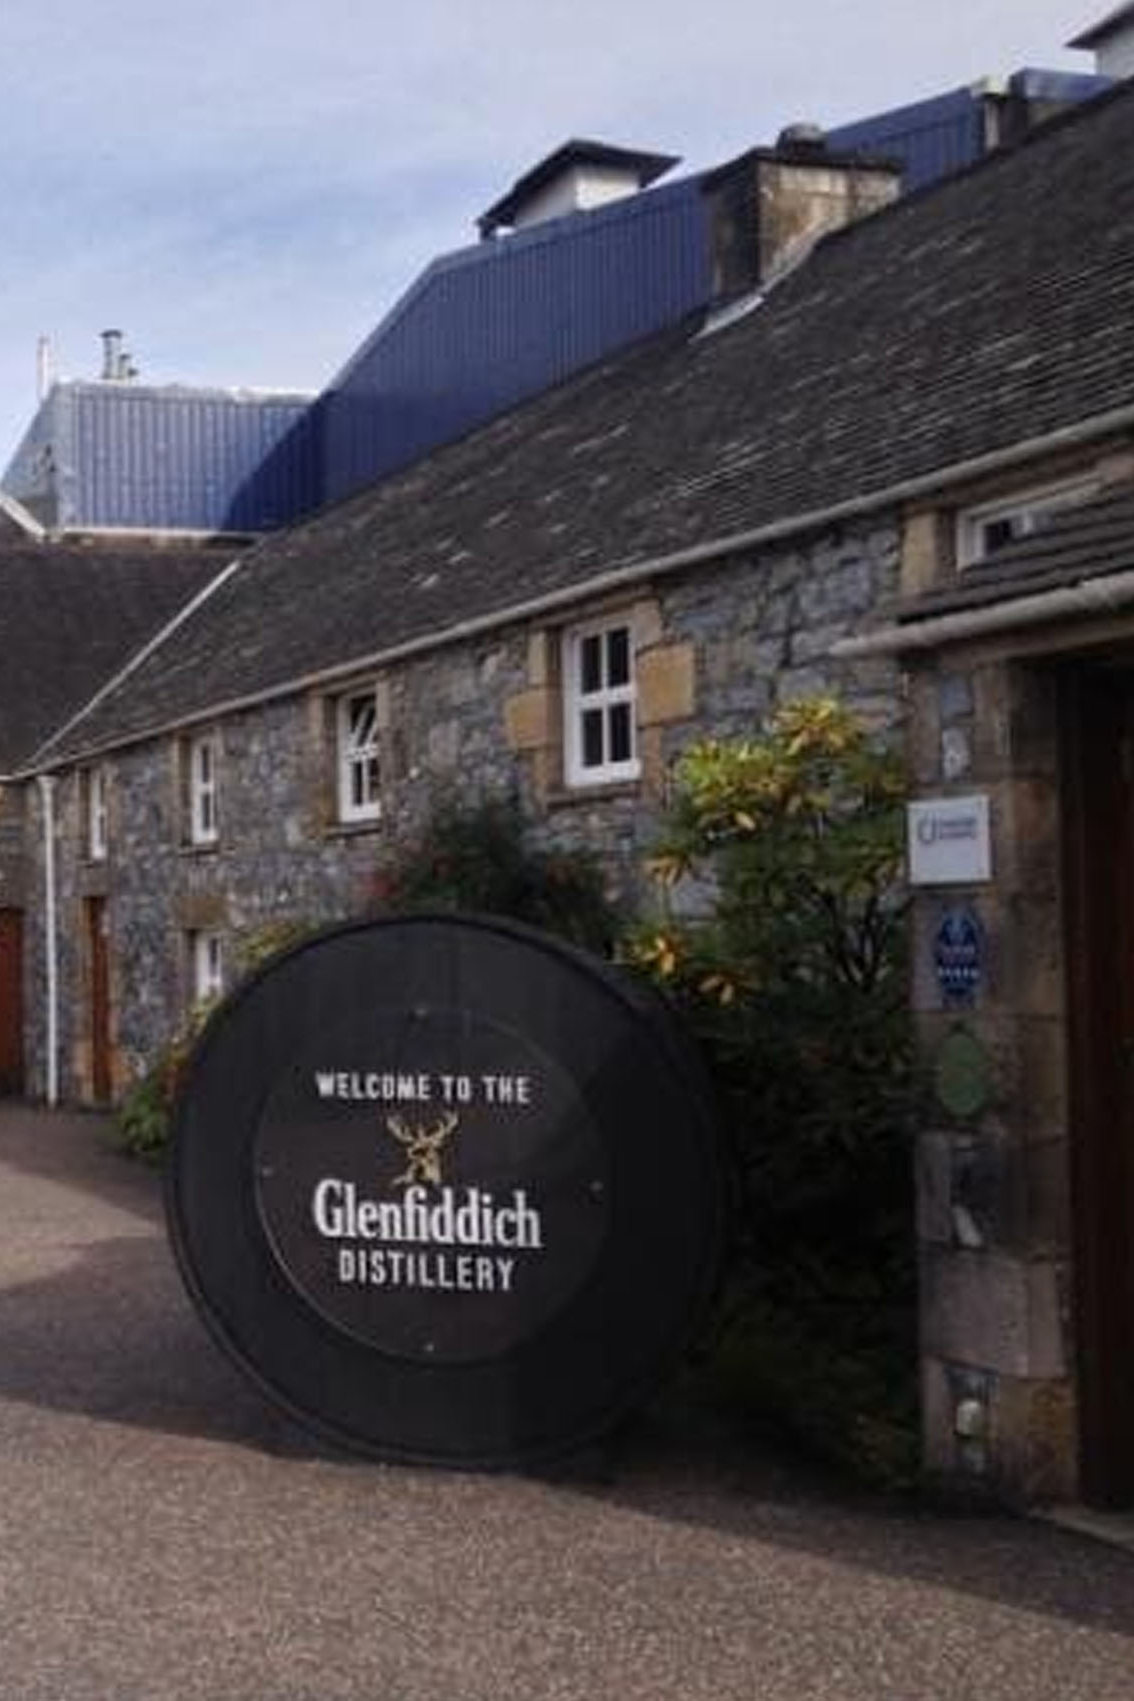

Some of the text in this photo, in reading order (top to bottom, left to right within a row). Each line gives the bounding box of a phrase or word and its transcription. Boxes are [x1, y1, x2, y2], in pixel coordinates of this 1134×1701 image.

[316, 1072, 531, 1103] WELCOME TO THE
[313, 1178, 543, 1248] Glenfiddich
[339, 1249, 514, 1290] DISTILLERY
